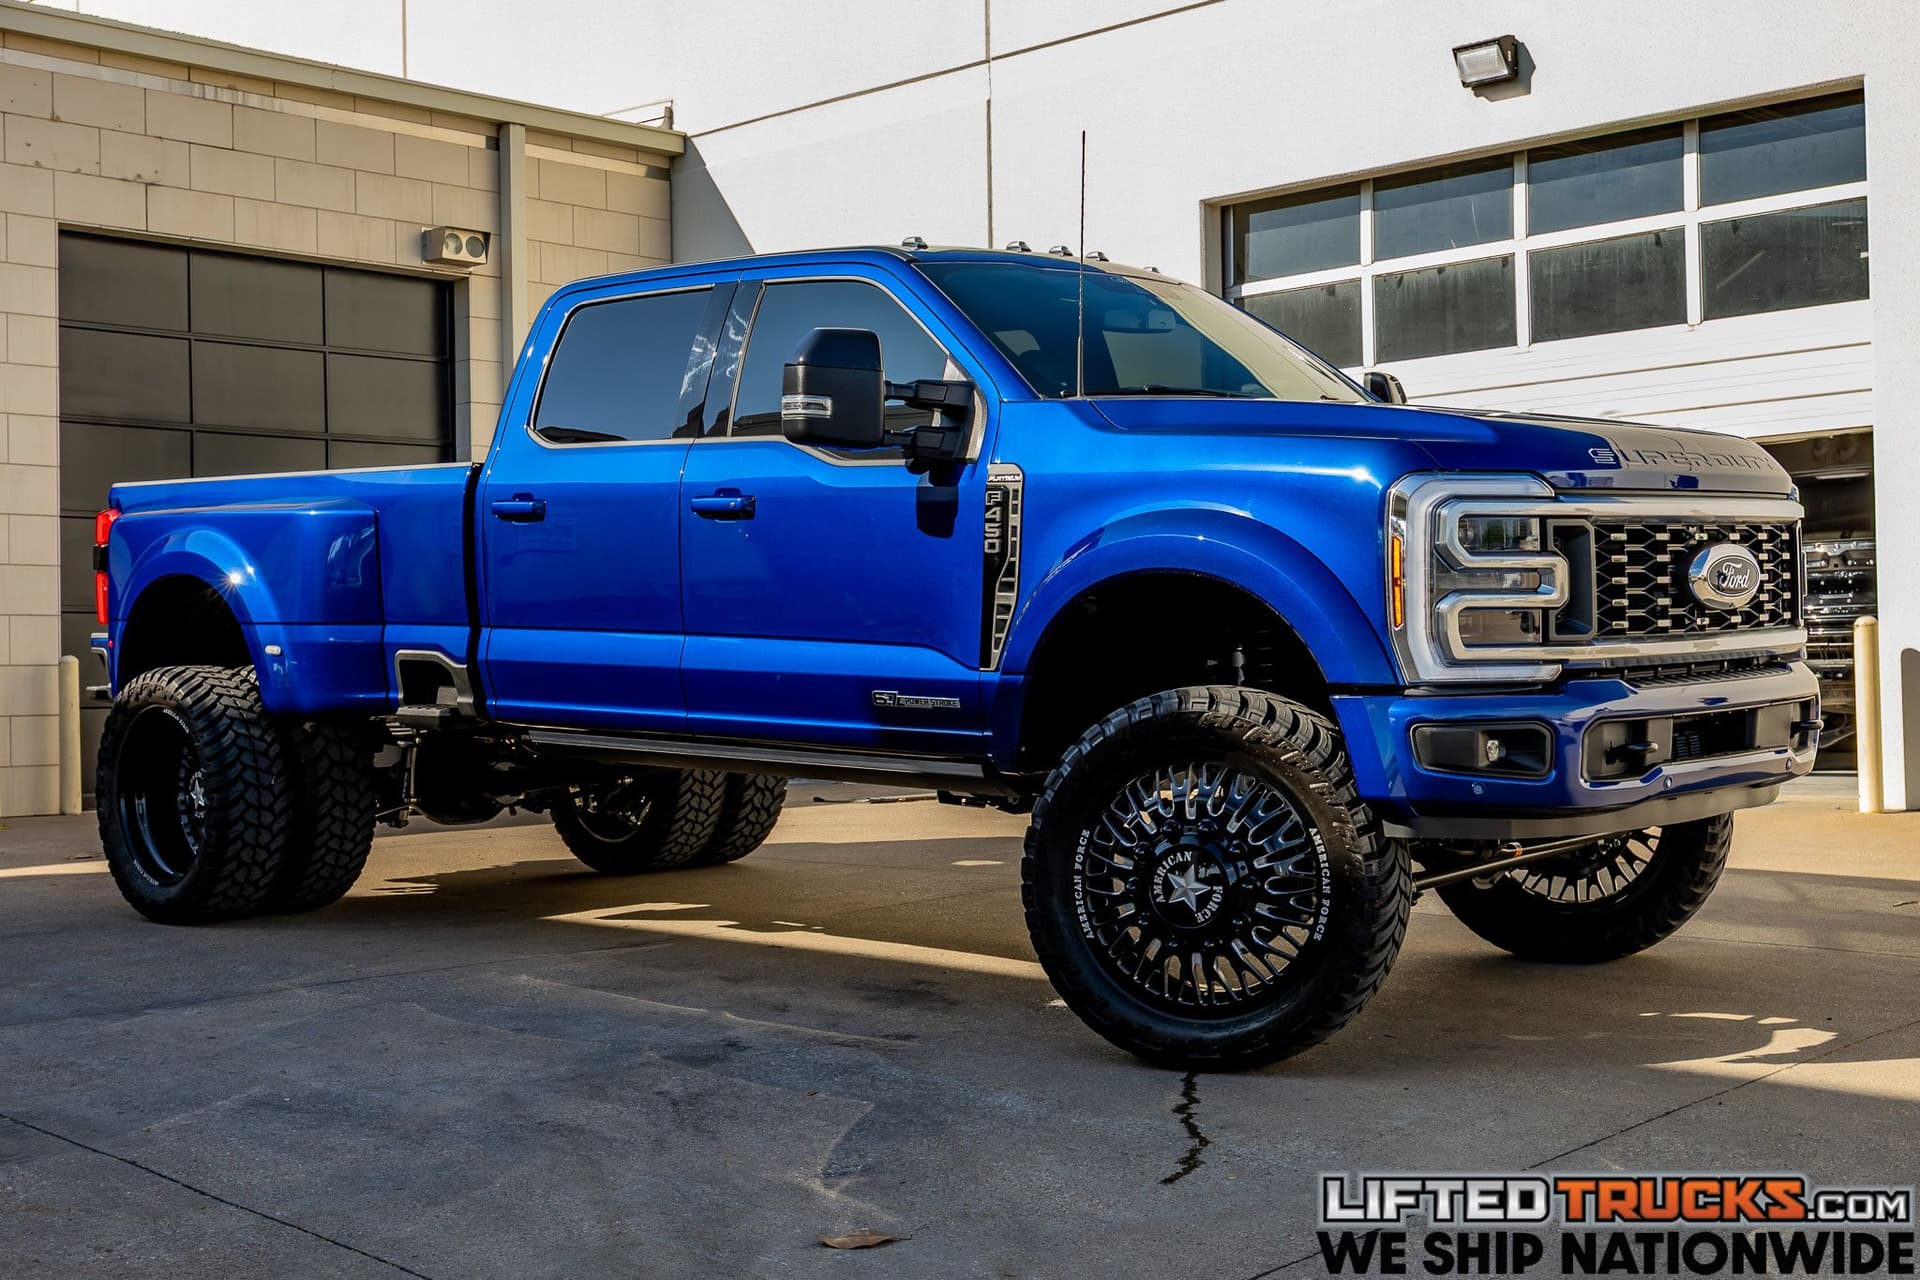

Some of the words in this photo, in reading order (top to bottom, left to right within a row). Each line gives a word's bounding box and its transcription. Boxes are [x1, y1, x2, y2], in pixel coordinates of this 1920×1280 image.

[1719, 561, 1750, 588] Ford
[1074, 829, 1090, 870] FORCE
[1308, 828, 1331, 893] AMERICAN
[1074, 875, 1095, 939] AMERICAN
[1153, 851, 1192, 903] AMERICAN
[1194, 885, 1223, 923] FORCE
[1313, 898, 1330, 941] FORCE
